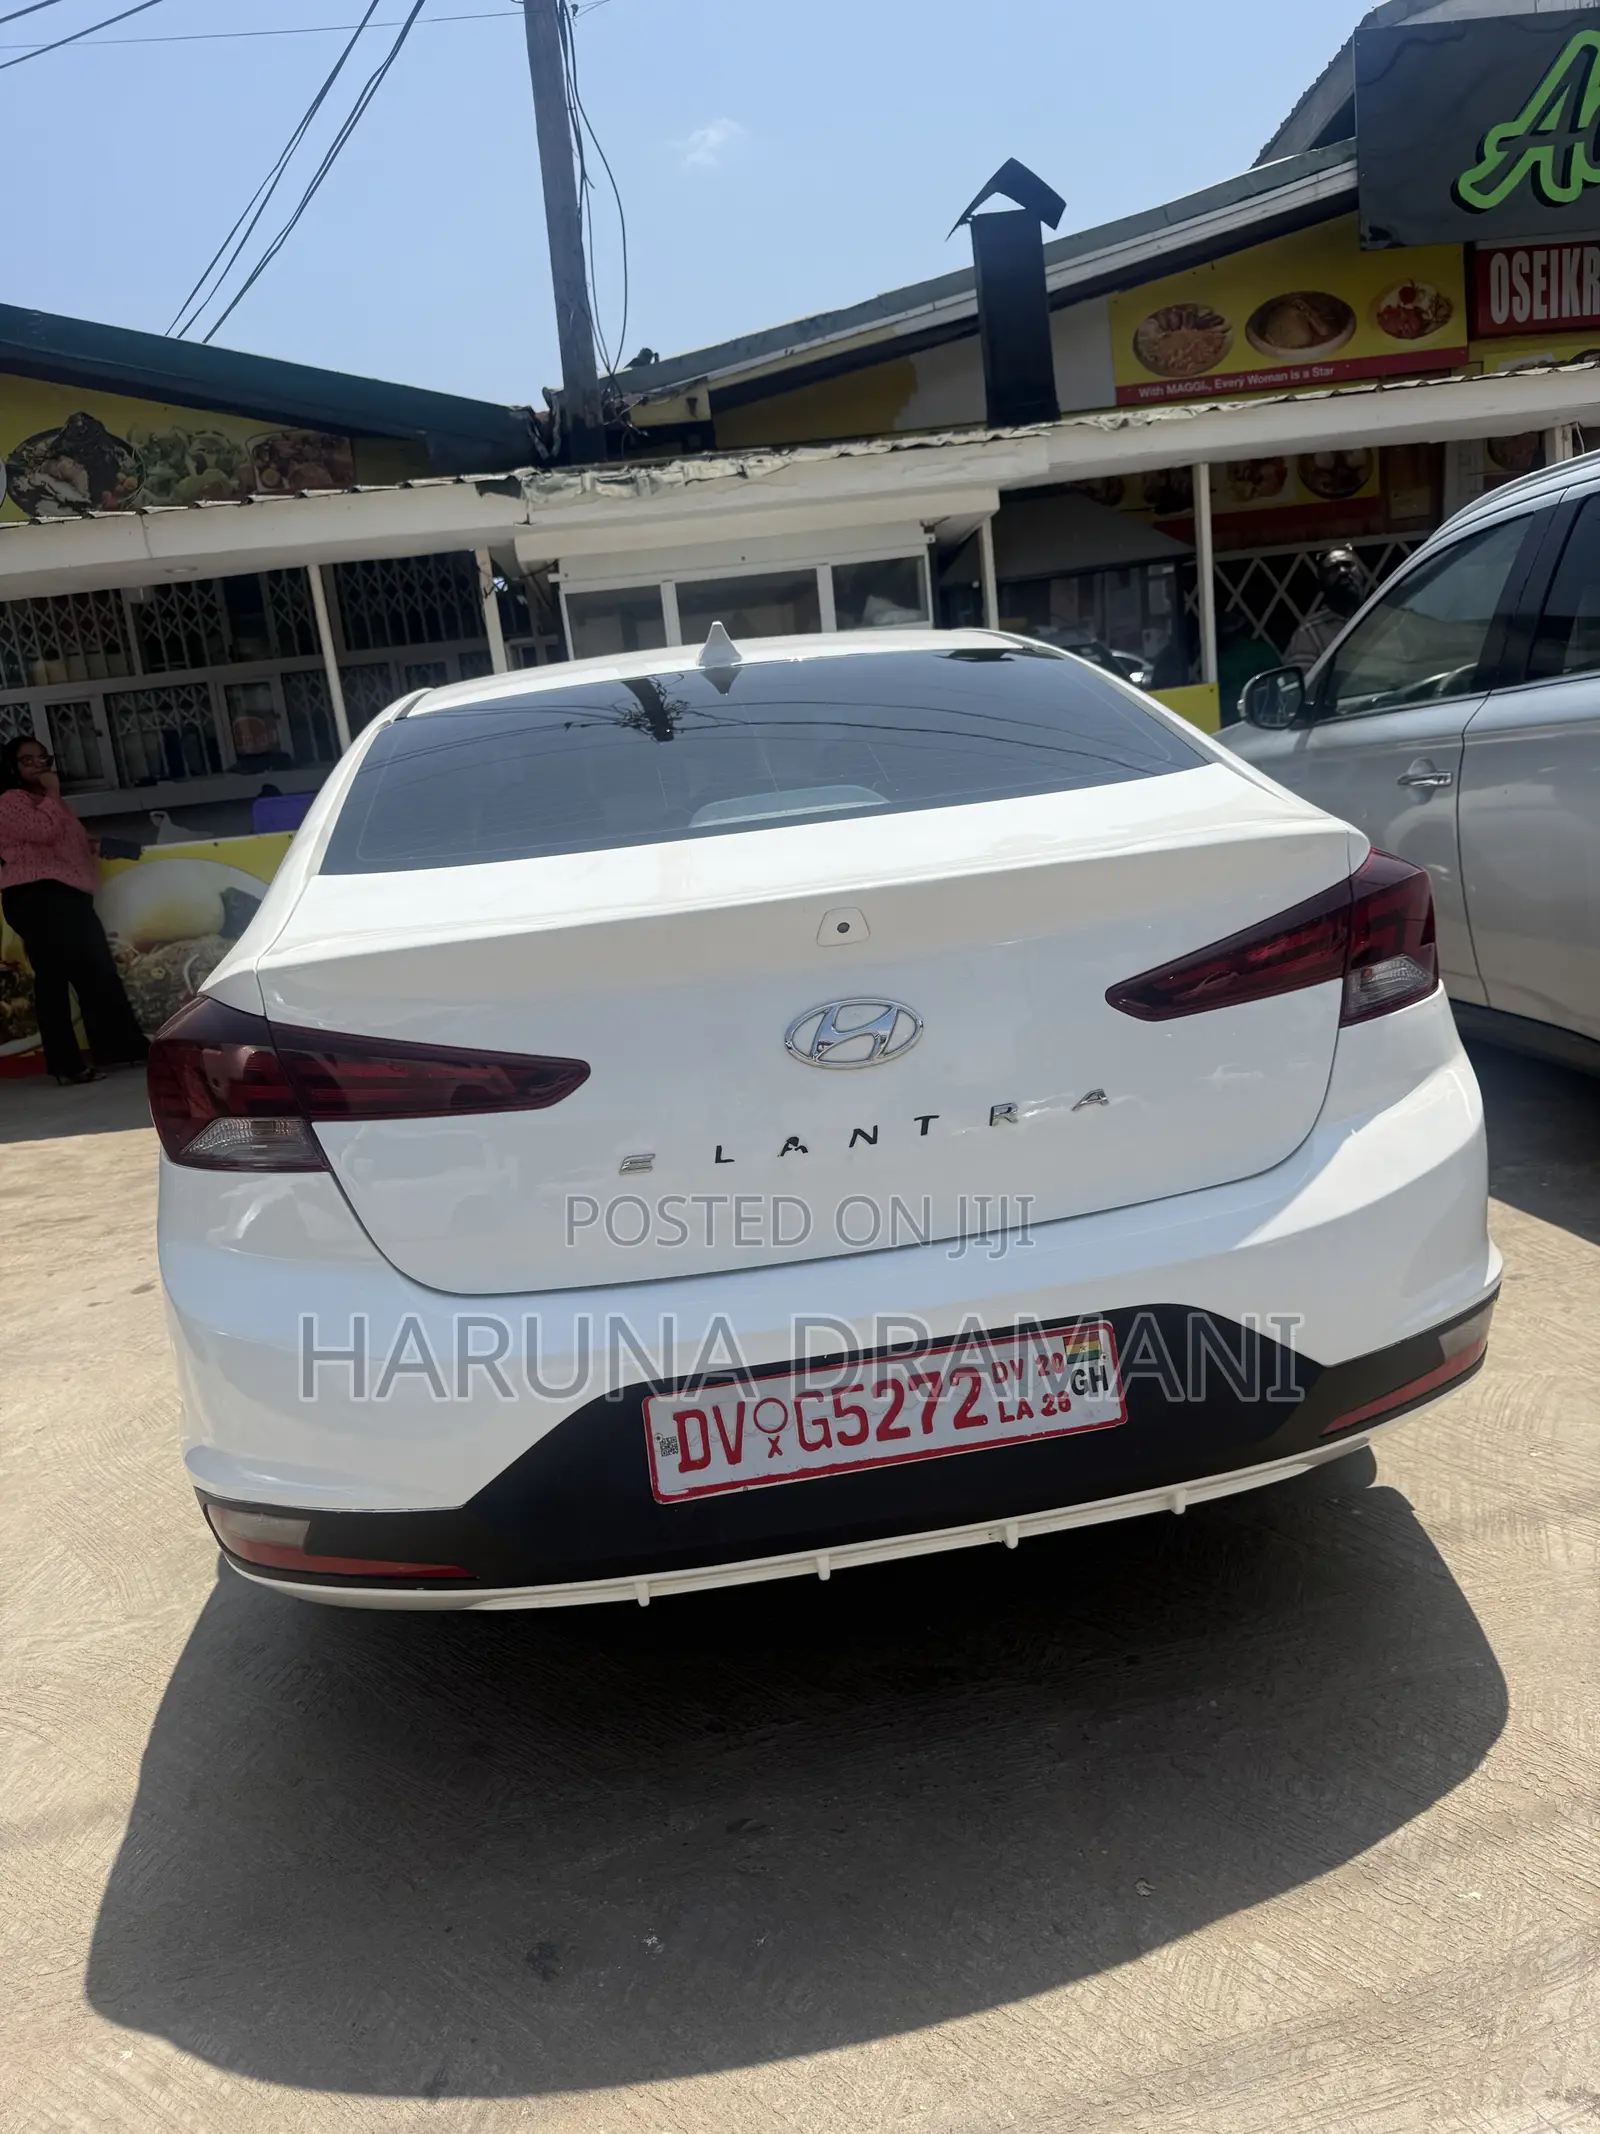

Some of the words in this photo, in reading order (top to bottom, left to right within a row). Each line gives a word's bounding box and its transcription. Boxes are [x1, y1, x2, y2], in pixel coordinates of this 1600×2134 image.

[1458, 29, 1600, 209] A
[1139, 386, 1164, 398] With
[1214, 375, 1245, 390] Every
[1247, 372, 1288, 385] Woman
[1290, 368, 1300, 380] is
[1302, 370, 1310, 379] a
[1312, 366, 1334, 377] Star
[618, 1088, 1109, 1175] ELANTRA
[990, 1358, 1024, 1384] DV
[1035, 1351, 1065, 1377] 20
[1070, 1364, 1109, 1396] GH
[672, 1401, 746, 1474] DV
[793, 1366, 989, 1452] G5272
[998, 1397, 1035, 1424] LA
